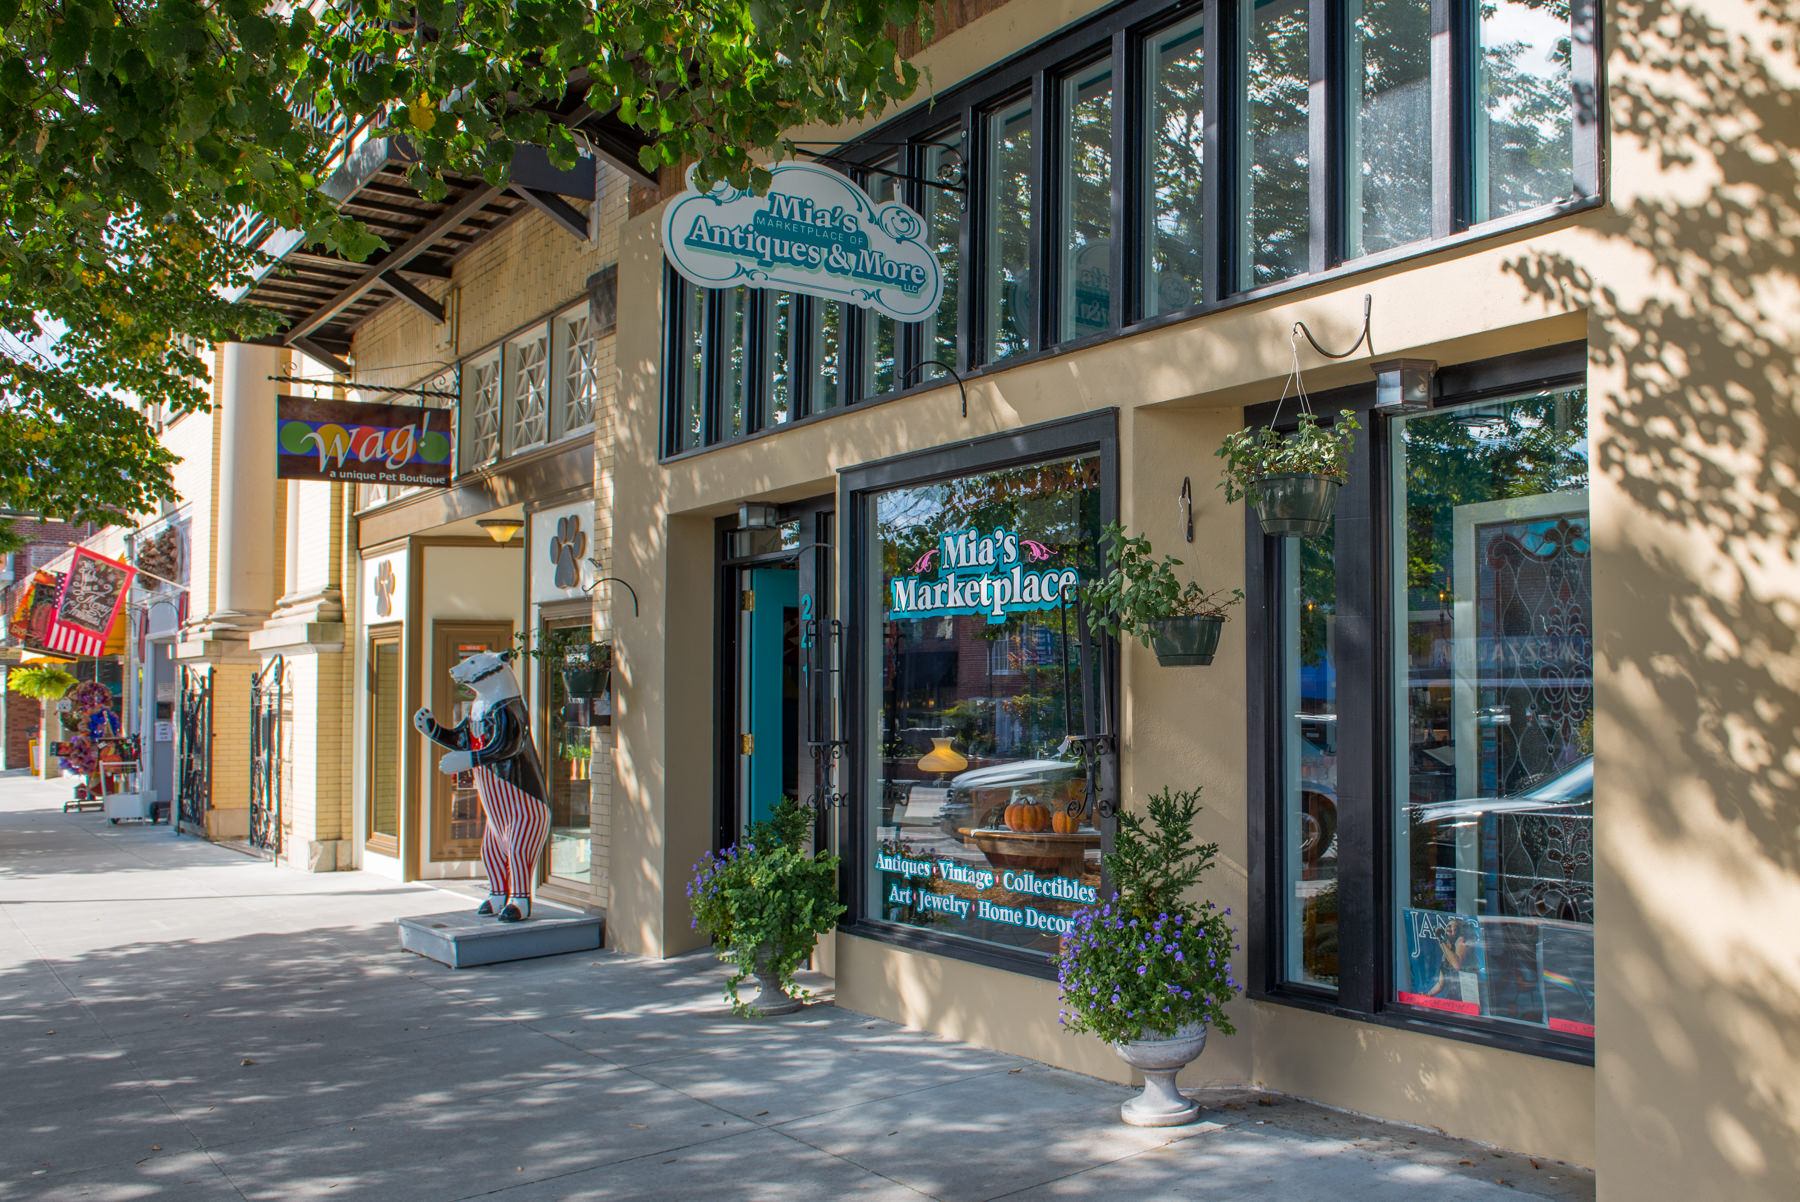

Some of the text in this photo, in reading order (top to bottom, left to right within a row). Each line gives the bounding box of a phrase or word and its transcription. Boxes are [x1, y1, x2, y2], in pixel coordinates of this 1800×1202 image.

[756, 216, 863, 246] MARKETPLACE OF
[768, 193, 859, 234] Mia's
[689, 215, 926, 285] Antiques & More
[903, 284, 919, 293] LLC
[299, 410, 431, 473] Wag!
[329, 470, 446, 486] a unique Pet Boutique
[942, 529, 1017, 570] Mia's
[893, 565, 1077, 616] Marketplace
[875, 852, 1096, 903] Antiques Vintage Collectibles
[889, 884, 1075, 934] Art Jewelry Home Decor
[1410, 911, 1479, 958] JAN
